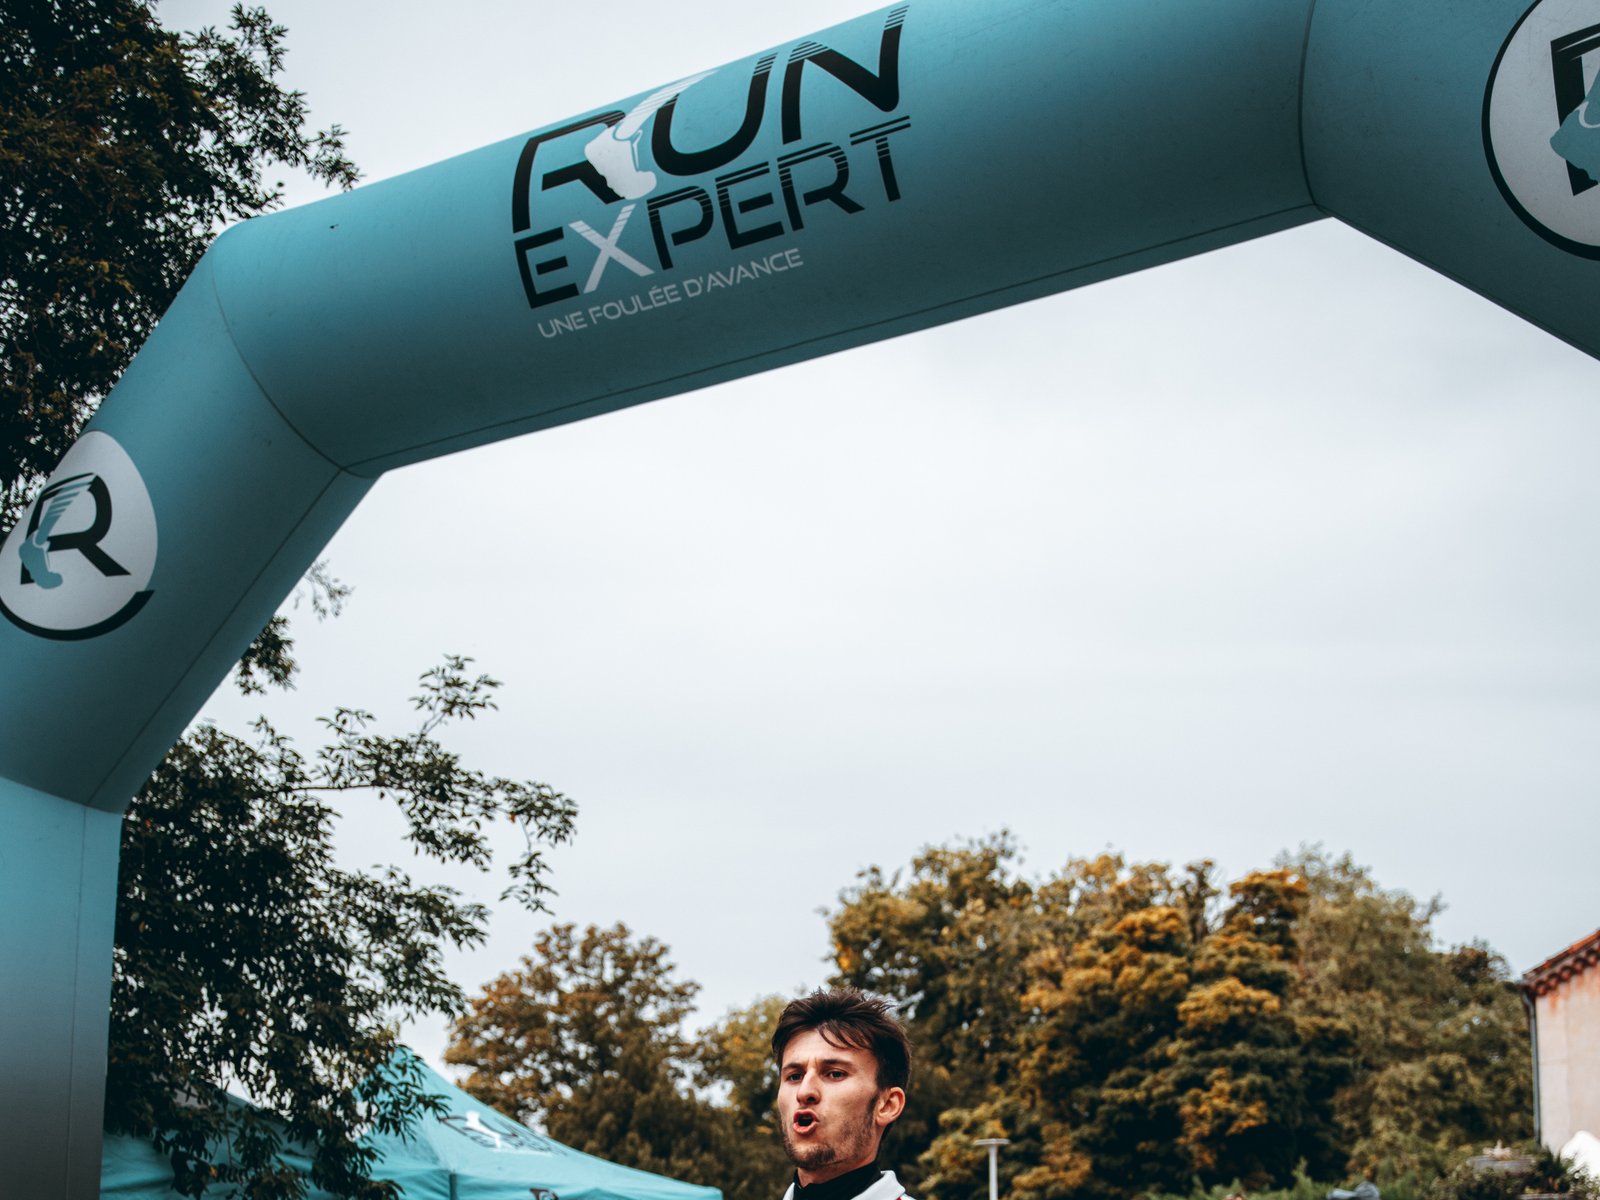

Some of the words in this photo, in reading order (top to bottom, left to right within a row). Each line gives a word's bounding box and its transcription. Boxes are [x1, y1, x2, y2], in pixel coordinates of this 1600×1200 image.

[512, 4, 910, 235] RUN
[513, 116, 912, 310] EXPERT
[537, 310, 588, 339] UNE
[588, 284, 682, 325] FOULÉE
[683, 248, 804, 297] D'AVANCE
